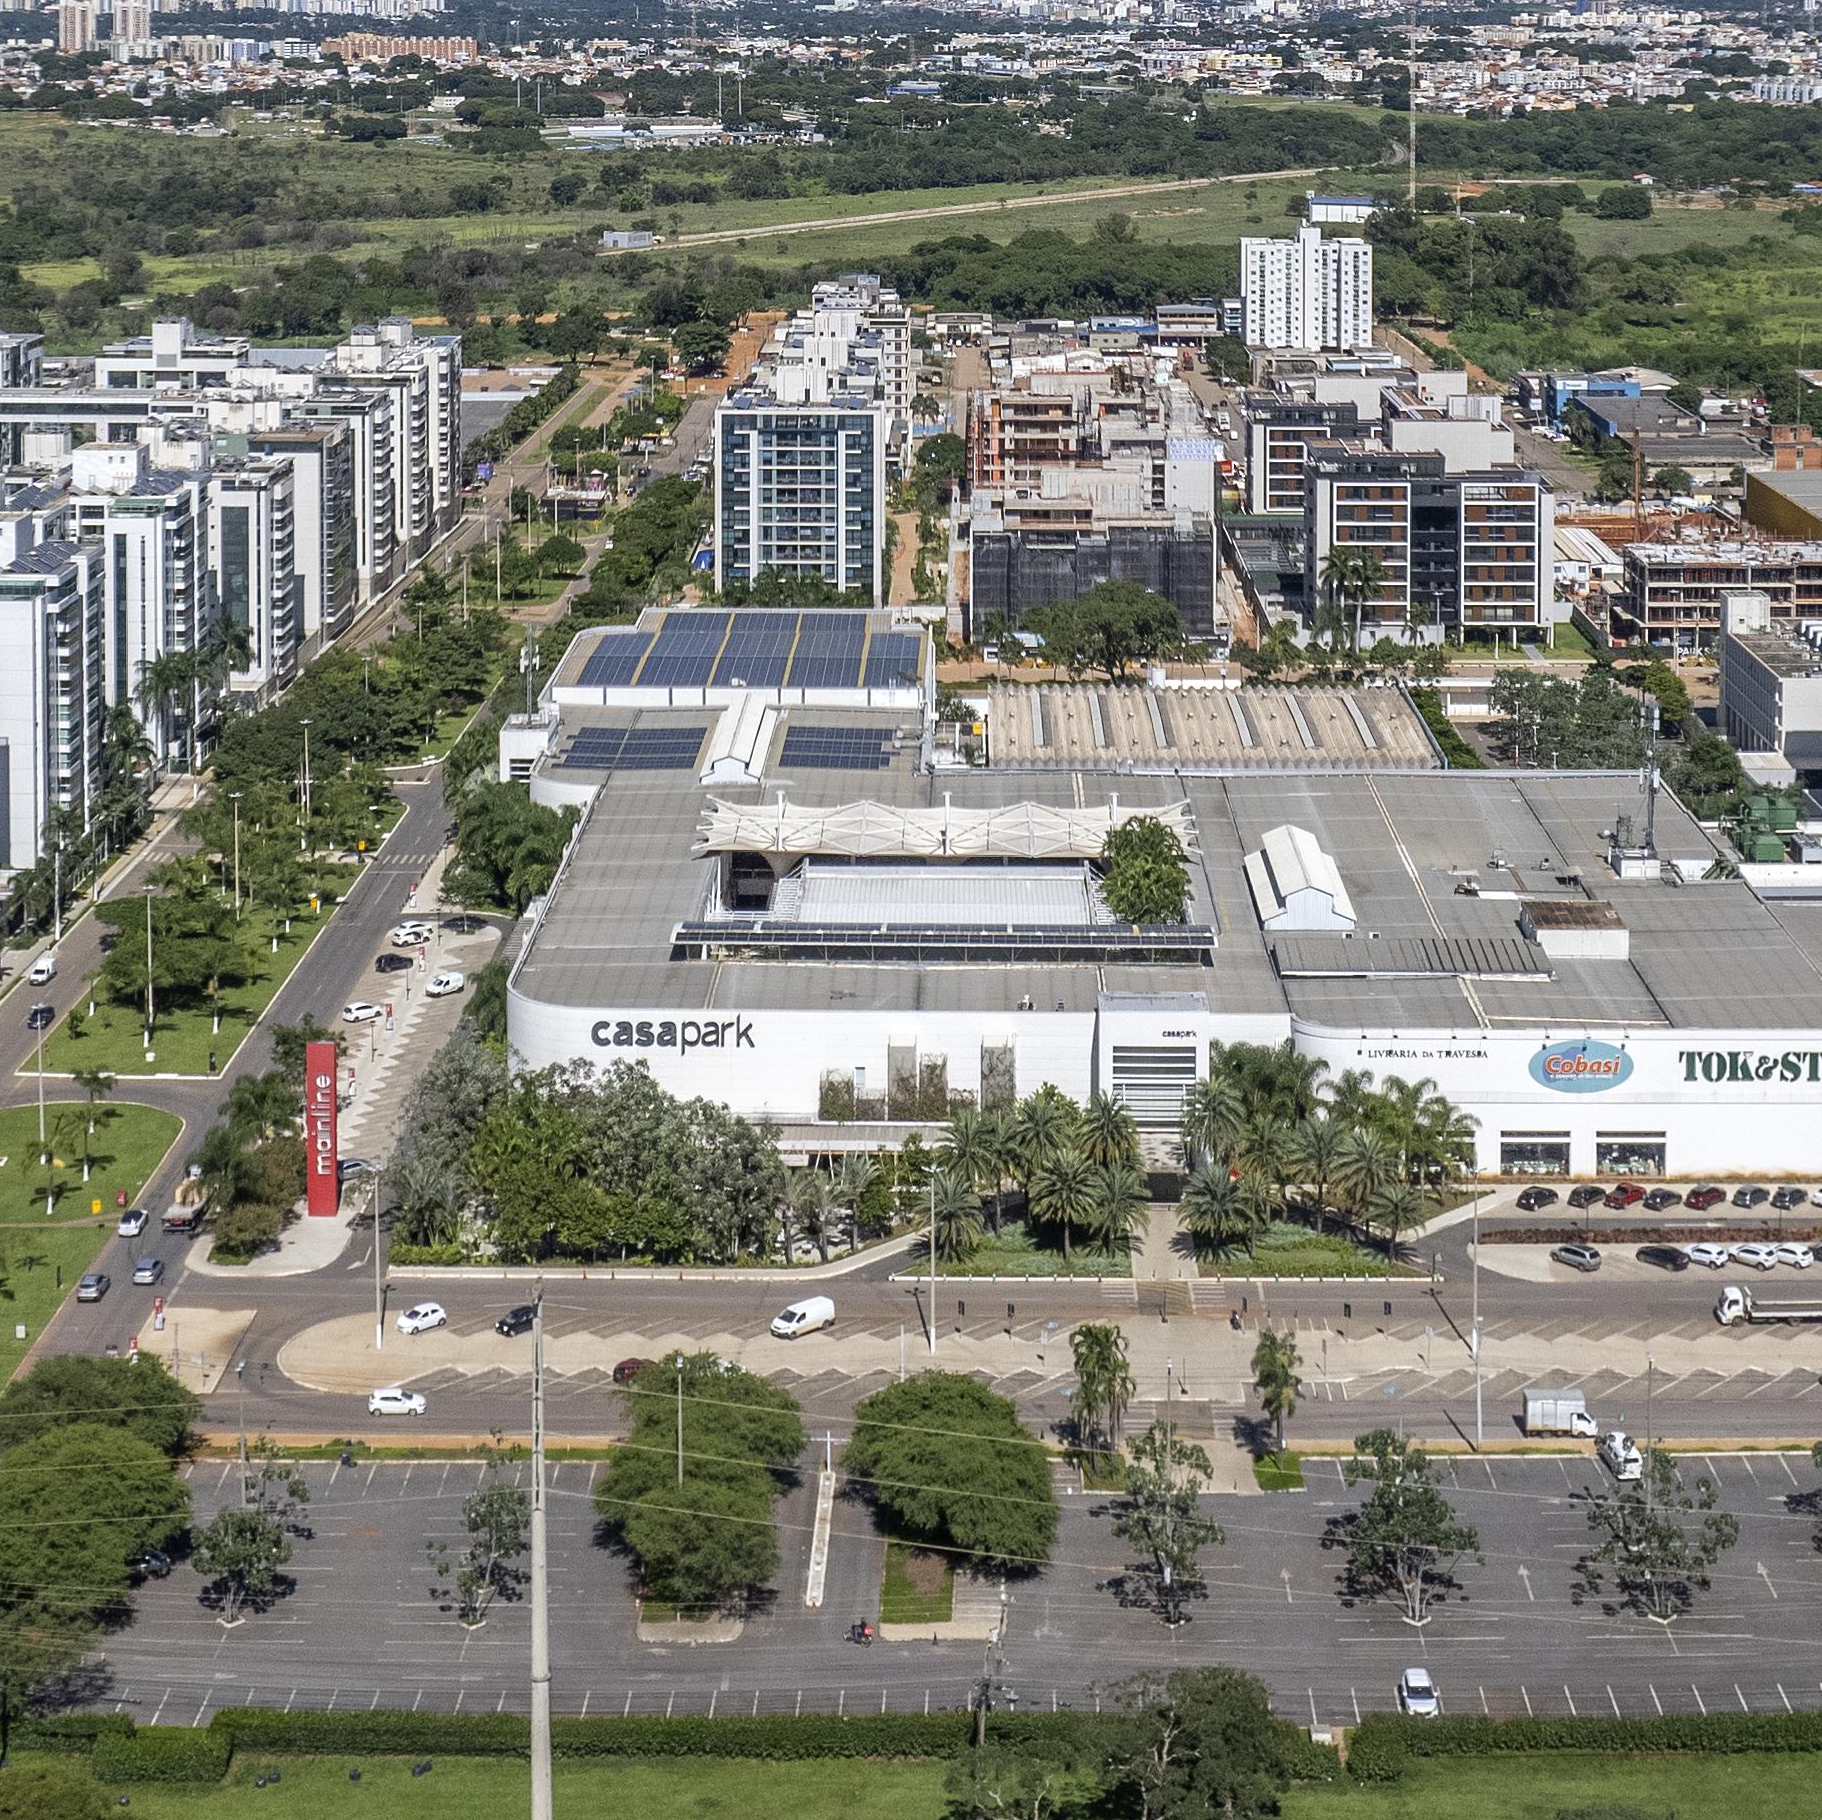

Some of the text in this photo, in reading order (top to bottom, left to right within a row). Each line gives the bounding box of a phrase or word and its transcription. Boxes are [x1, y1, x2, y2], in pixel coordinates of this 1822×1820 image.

[591, 1013, 756, 1057] casapark
[1367, 1049, 1418, 1059] LIVRARIA
[1422, 1050, 1434, 1058] DA
[1545, 1054, 1621, 1074] Cobasi
